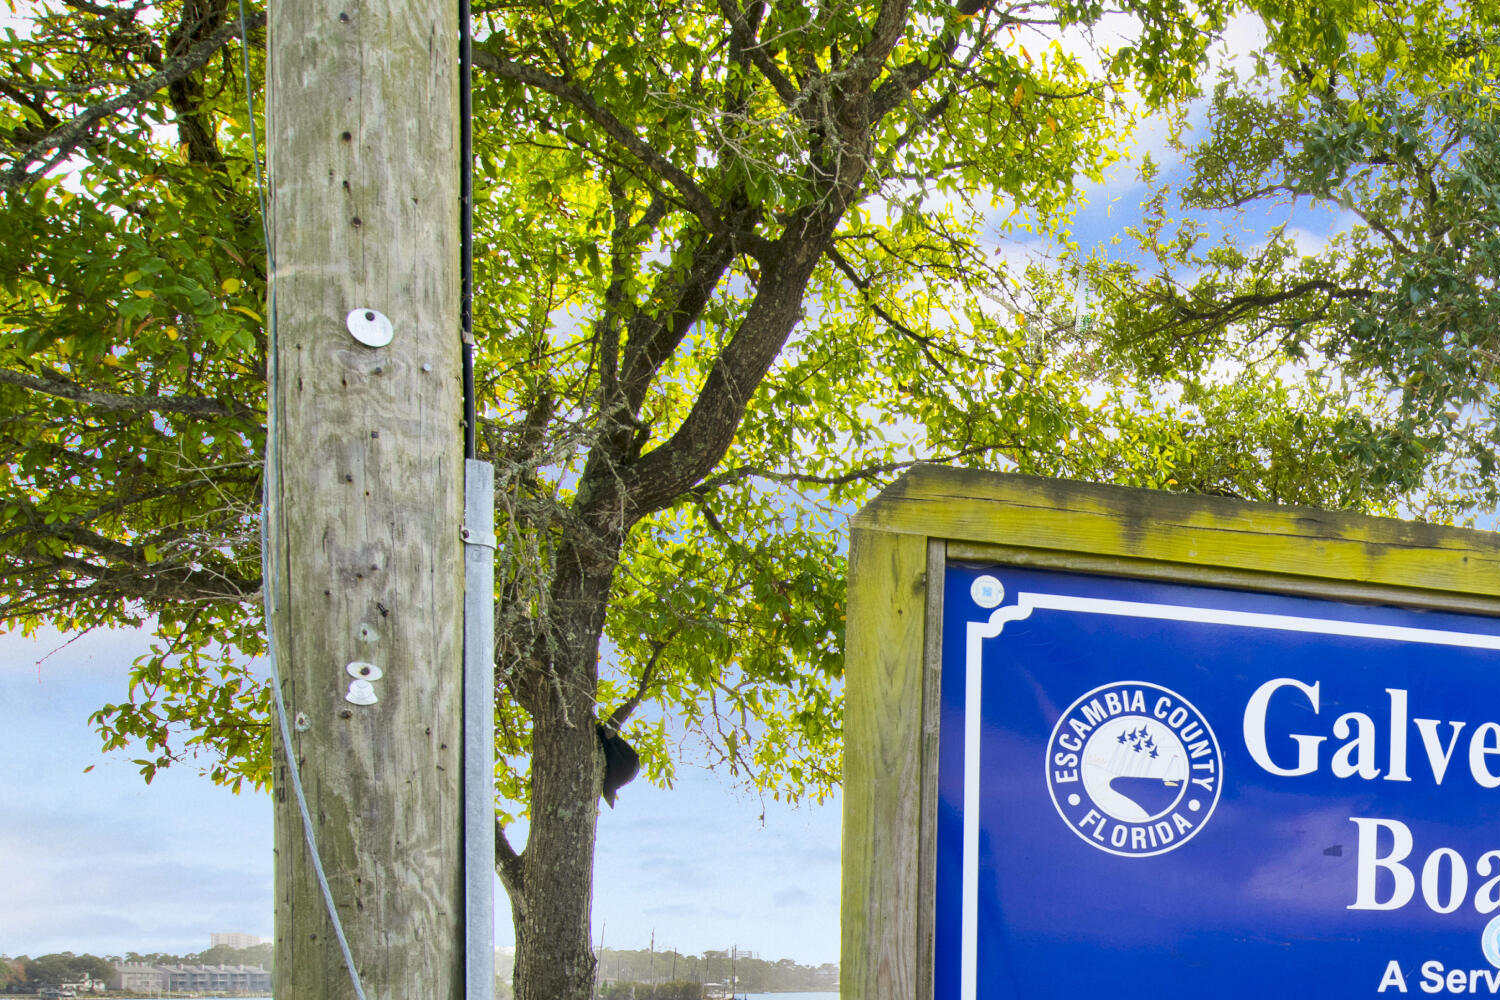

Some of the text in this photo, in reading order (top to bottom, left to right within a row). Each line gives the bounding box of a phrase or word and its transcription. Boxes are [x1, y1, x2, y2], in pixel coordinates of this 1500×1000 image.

[1055, 690, 1216, 792] ESCAMBIA COUNTY
[1078, 809, 1194, 850] FLORIDA
[1378, 961, 1408, 993] A
